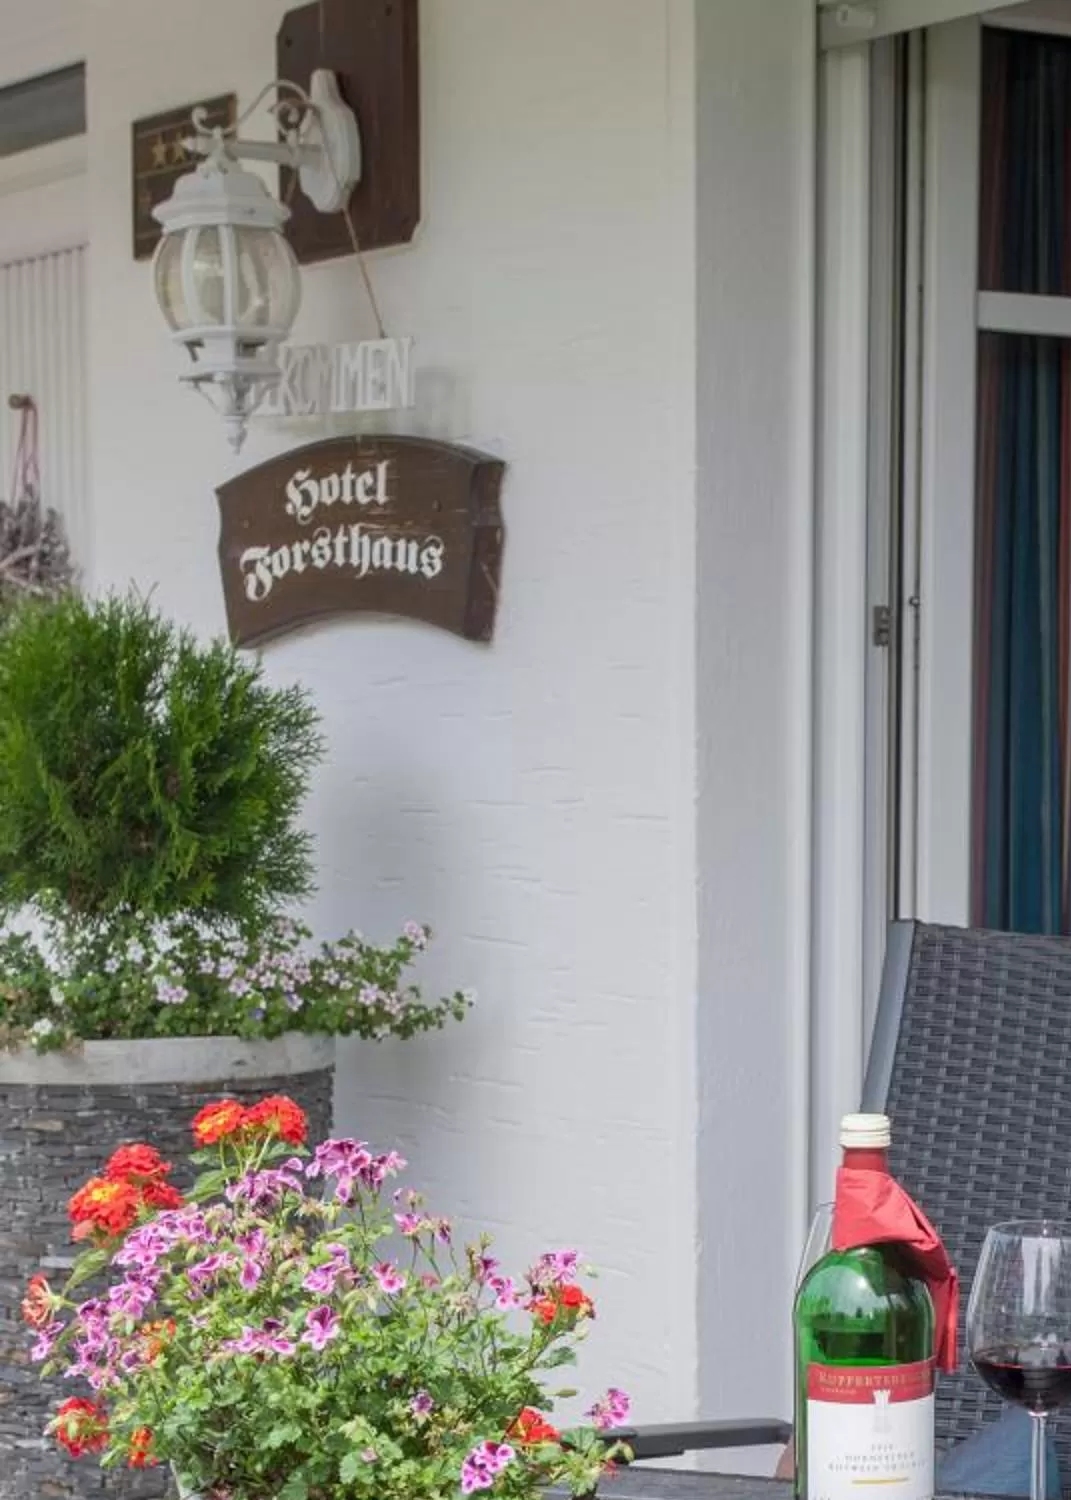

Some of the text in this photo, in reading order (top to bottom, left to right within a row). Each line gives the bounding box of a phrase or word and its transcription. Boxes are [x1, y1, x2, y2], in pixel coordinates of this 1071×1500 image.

[251, 338, 415, 416] KOMMEN
[285, 459, 391, 525] Hotel
[239, 522, 446, 602] Forsthaus
